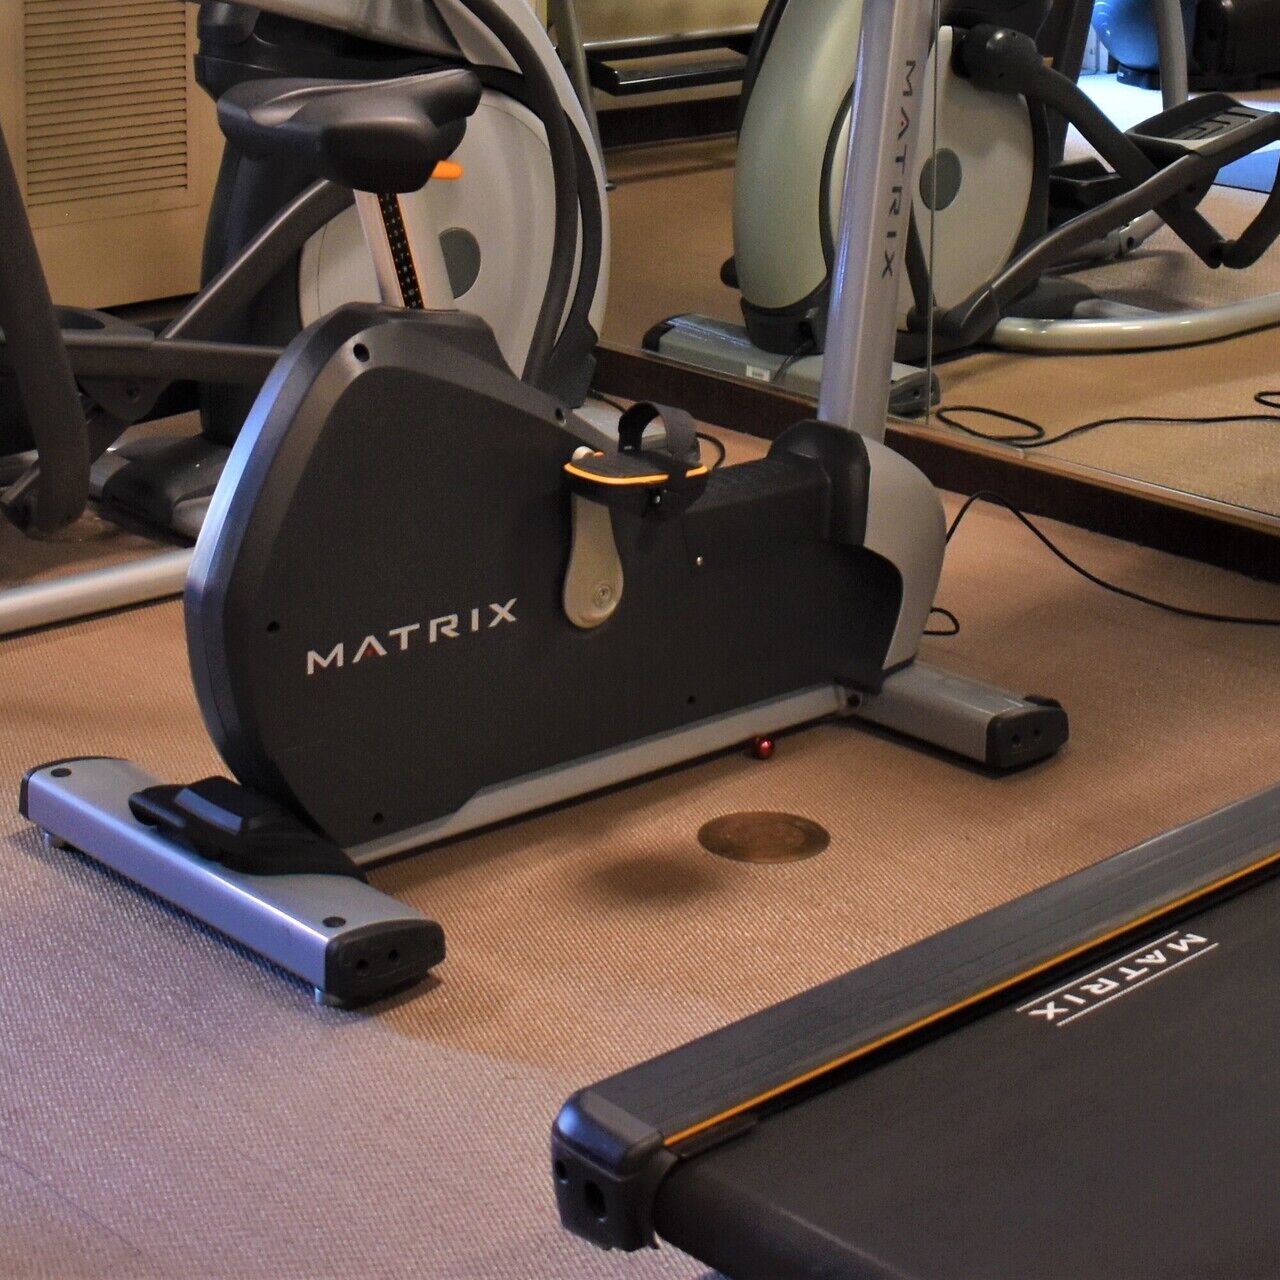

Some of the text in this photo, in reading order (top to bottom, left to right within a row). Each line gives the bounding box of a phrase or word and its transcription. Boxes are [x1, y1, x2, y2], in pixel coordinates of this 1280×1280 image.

[882, 60, 917, 280] MATRIX
[306, 597, 519, 676] MATRIX
[1028, 933, 1208, 1021] MATRIX
